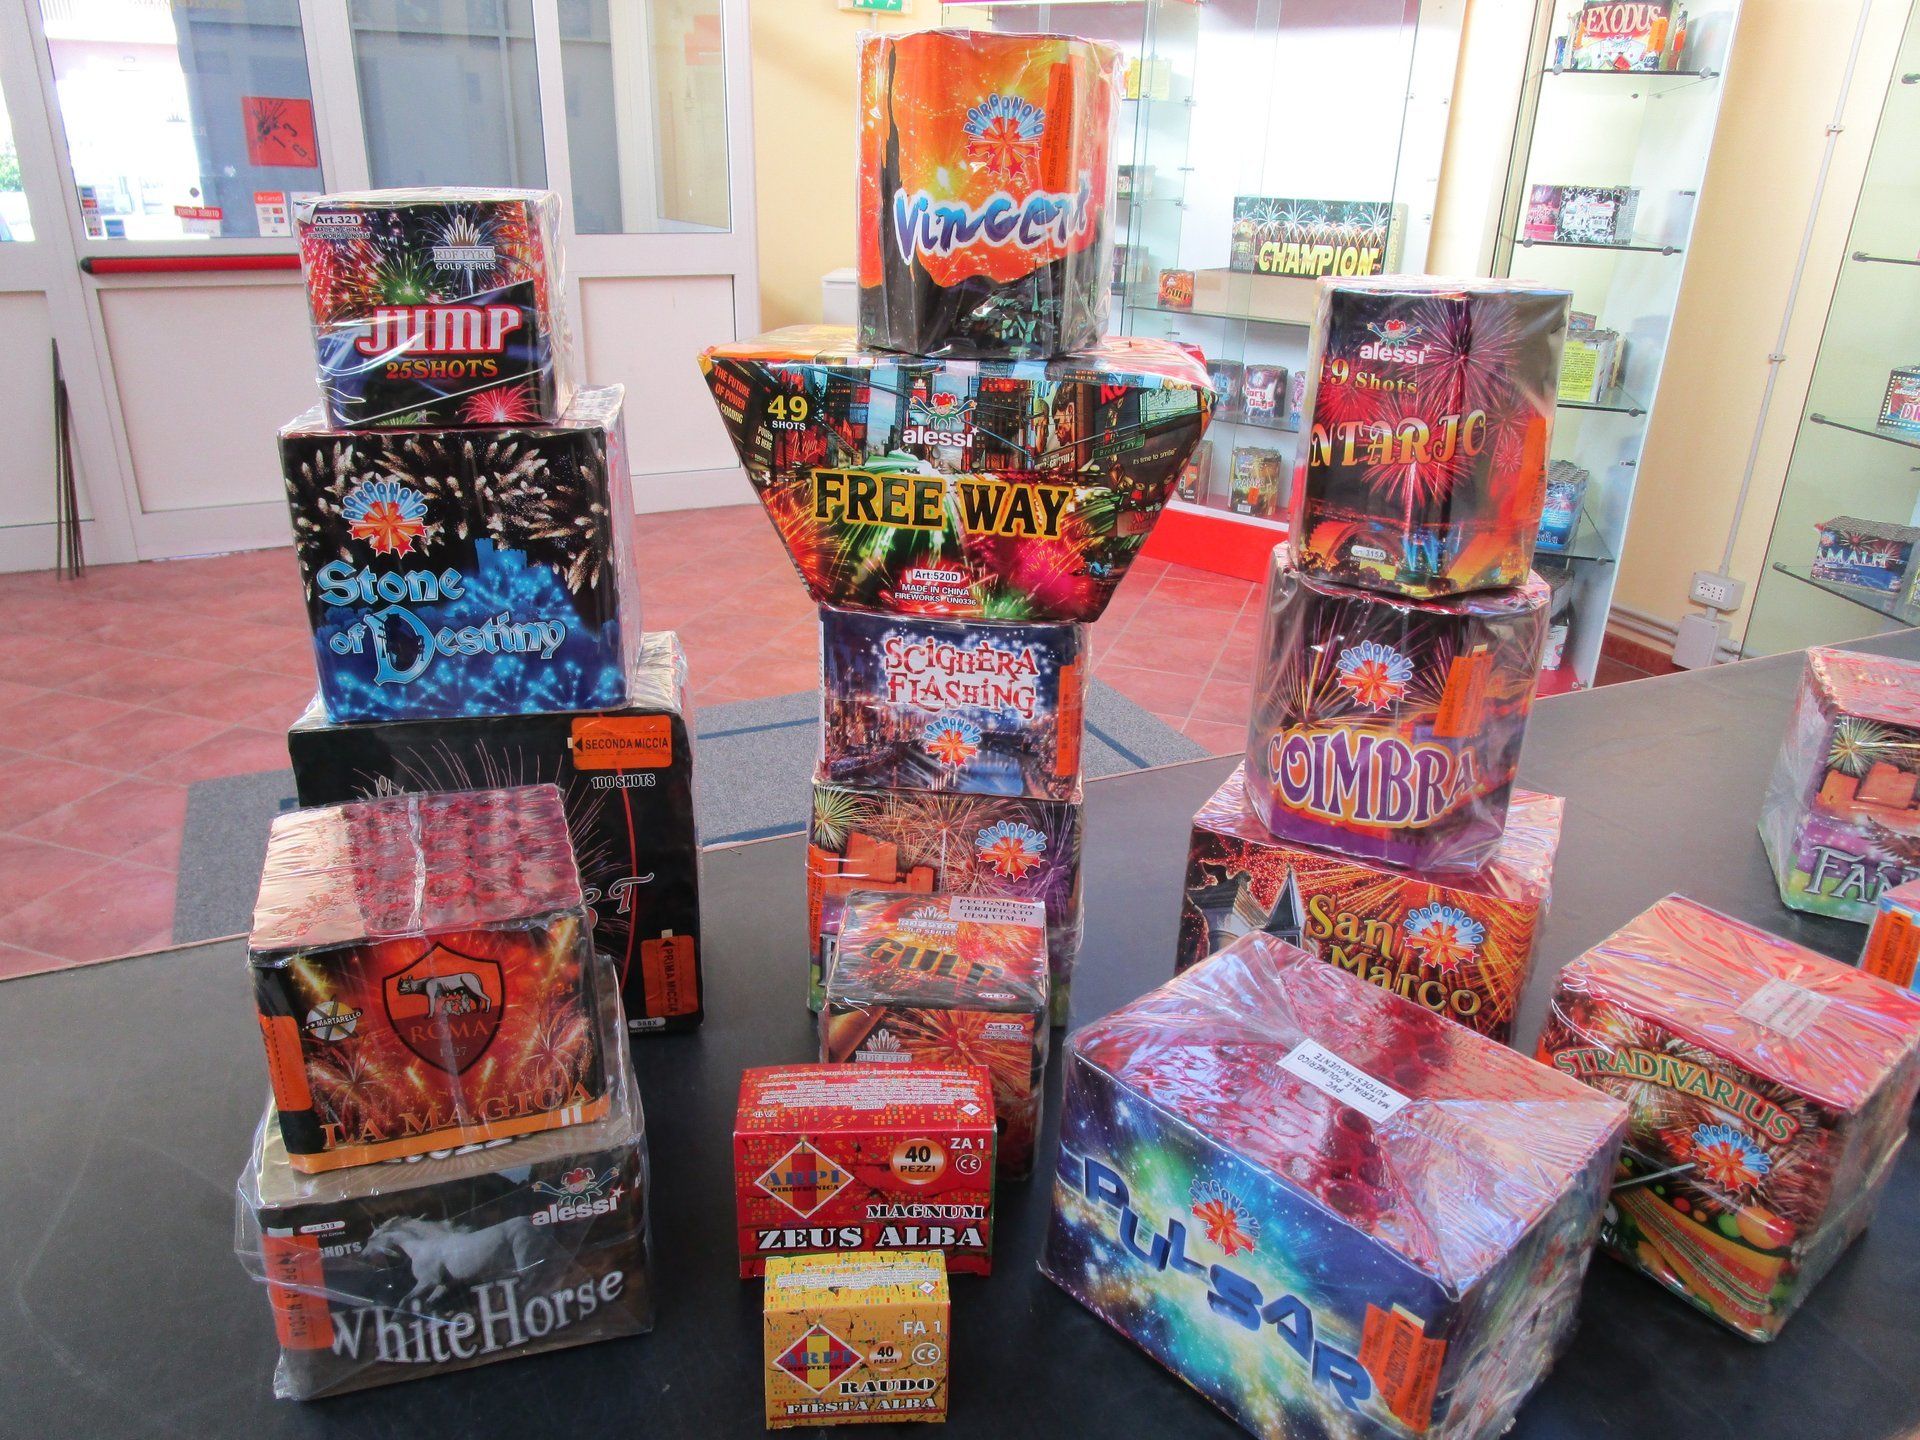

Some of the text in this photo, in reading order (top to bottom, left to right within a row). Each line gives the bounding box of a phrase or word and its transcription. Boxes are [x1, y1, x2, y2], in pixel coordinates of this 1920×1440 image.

[1585, 3, 1661, 35] EXODUS
[315, 215, 360, 225] Art.321
[435, 261, 496, 270] GOLD SERIES
[1258, 241, 1380, 277] CHAMPION
[357, 306, 521, 354] JUMP
[1359, 341, 1433, 365] alessi
[386, 358, 498, 379] 25SHOTS
[714, 365, 750, 398] THE FUTURE
[1355, 369, 1418, 394] Shots
[715, 384, 746, 410] OF POWER
[767, 395, 808, 421] 49
[772, 420, 806, 431] SHOTS
[902, 425, 978, 448] alessi
[812, 470, 1075, 538] FREE WAY
[317, 560, 466, 606] Stone
[914, 570, 958, 582] Art:520D
[901, 583, 969, 596] MADE IN CHINA
[329, 604, 566, 687] of Destiny
[886, 671, 1036, 720] FLASHING
[585, 737, 669, 750] SECONDA MICCIA
[591, 773, 656, 789] 100 SHOTS
[1268, 729, 1477, 824] COIMBRA
[959, 905, 1033, 916] CERTIFICATO
[1306, 895, 1395, 961] San
[1403, 902, 1486, 944] BORGONOVO
[663, 947, 679, 1013] PRIMA MICCIA
[316, 1011, 362, 1027] MARTARELLO
[411, 1019, 490, 1043] ROMA
[1297, 1053, 1391, 1110] MATERIALE POLIMERICO
[1313, 1052, 1391, 1098] AUTOESTINGUENTE
[1325, 1081, 1343, 1094] PVC
[1552, 1047, 1801, 1145] STRADIVARIUS
[320, 1081, 595, 1150] LA MAGICA
[905, 1146, 931, 1162] 40
[950, 1138, 985, 1149] ZA 1
[764, 1169, 841, 1187] ARPI
[900, 1165, 936, 1173] PEZZI
[531, 1193, 620, 1227] alessi
[866, 1204, 985, 1219] MAGNUM
[758, 1226, 984, 1250] ZEUS ALBA
[1083, 1156, 1373, 1411] PULSAR
[903, 1320, 941, 1335] FA 1
[782, 1349, 853, 1366] ARPI
[877, 1346, 894, 1358] 40
[839, 1378, 936, 1395] RAUDO
[786, 1397, 937, 1415] FIESTA ALBA
